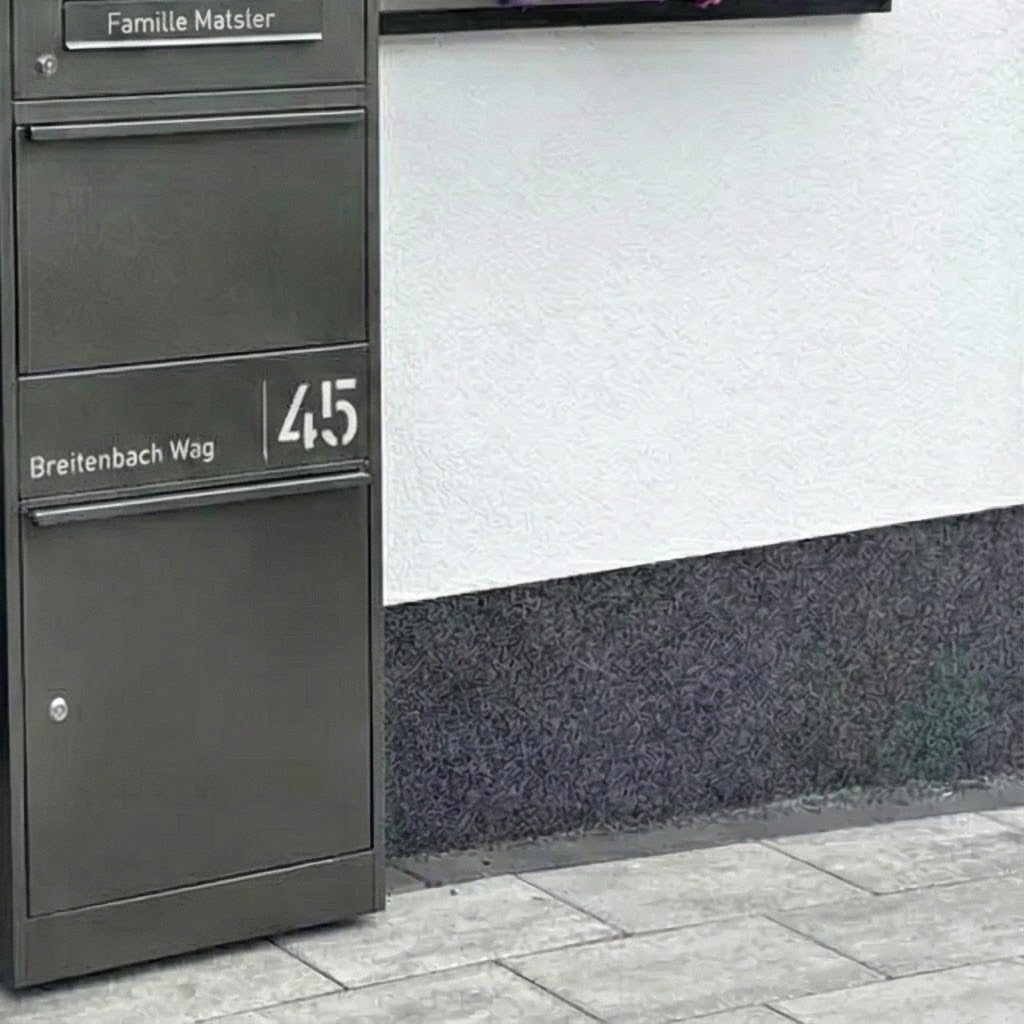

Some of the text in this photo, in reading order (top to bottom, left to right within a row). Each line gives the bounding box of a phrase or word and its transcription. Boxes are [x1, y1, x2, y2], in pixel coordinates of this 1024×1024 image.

[107, 10, 188, 35] Famille
[278, 378, 358, 450] 45
[29, 437, 215, 479] Breitenbach Wag
